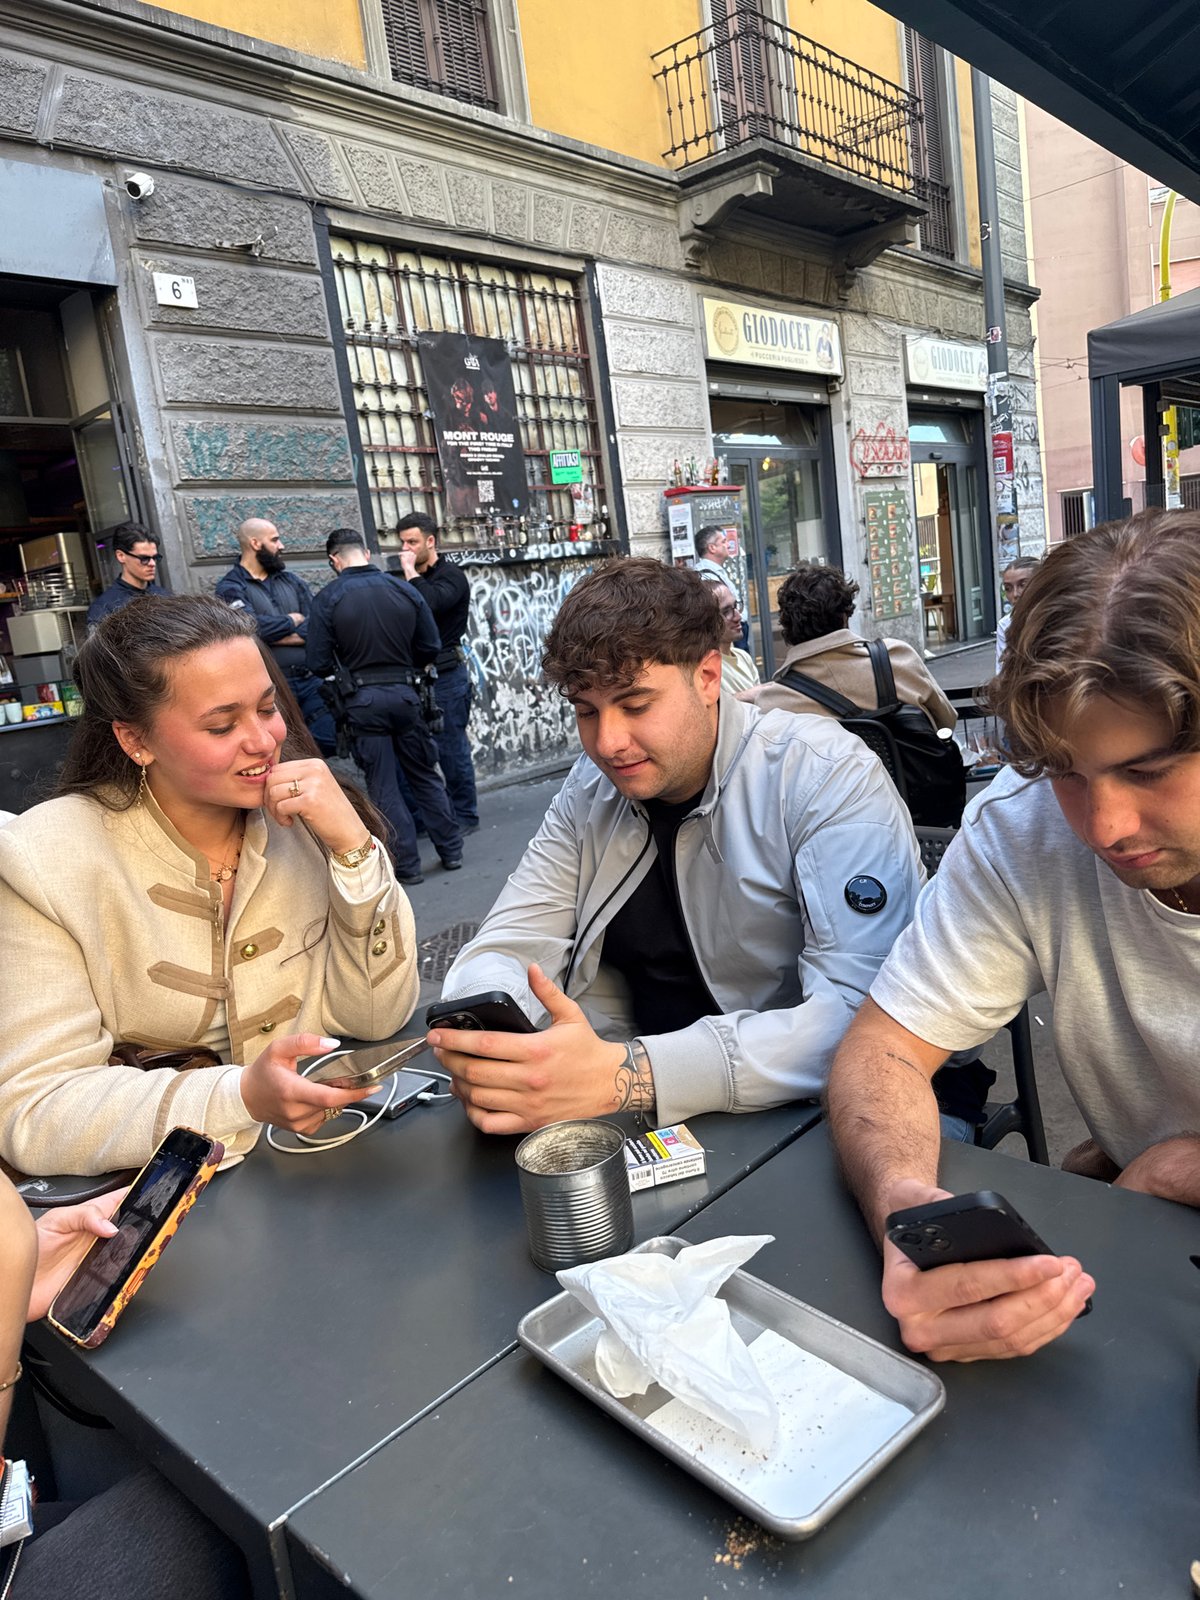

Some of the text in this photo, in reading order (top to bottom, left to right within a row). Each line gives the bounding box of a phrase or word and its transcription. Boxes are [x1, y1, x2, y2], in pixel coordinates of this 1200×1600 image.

[172, 281, 182, 299] 6
[743, 312, 811, 352] GIODOCET
[931, 345, 974, 374] GIODOCET
[443, 431, 514, 442] MONT ROUGE
[524, 541, 592, 560] SPORT
